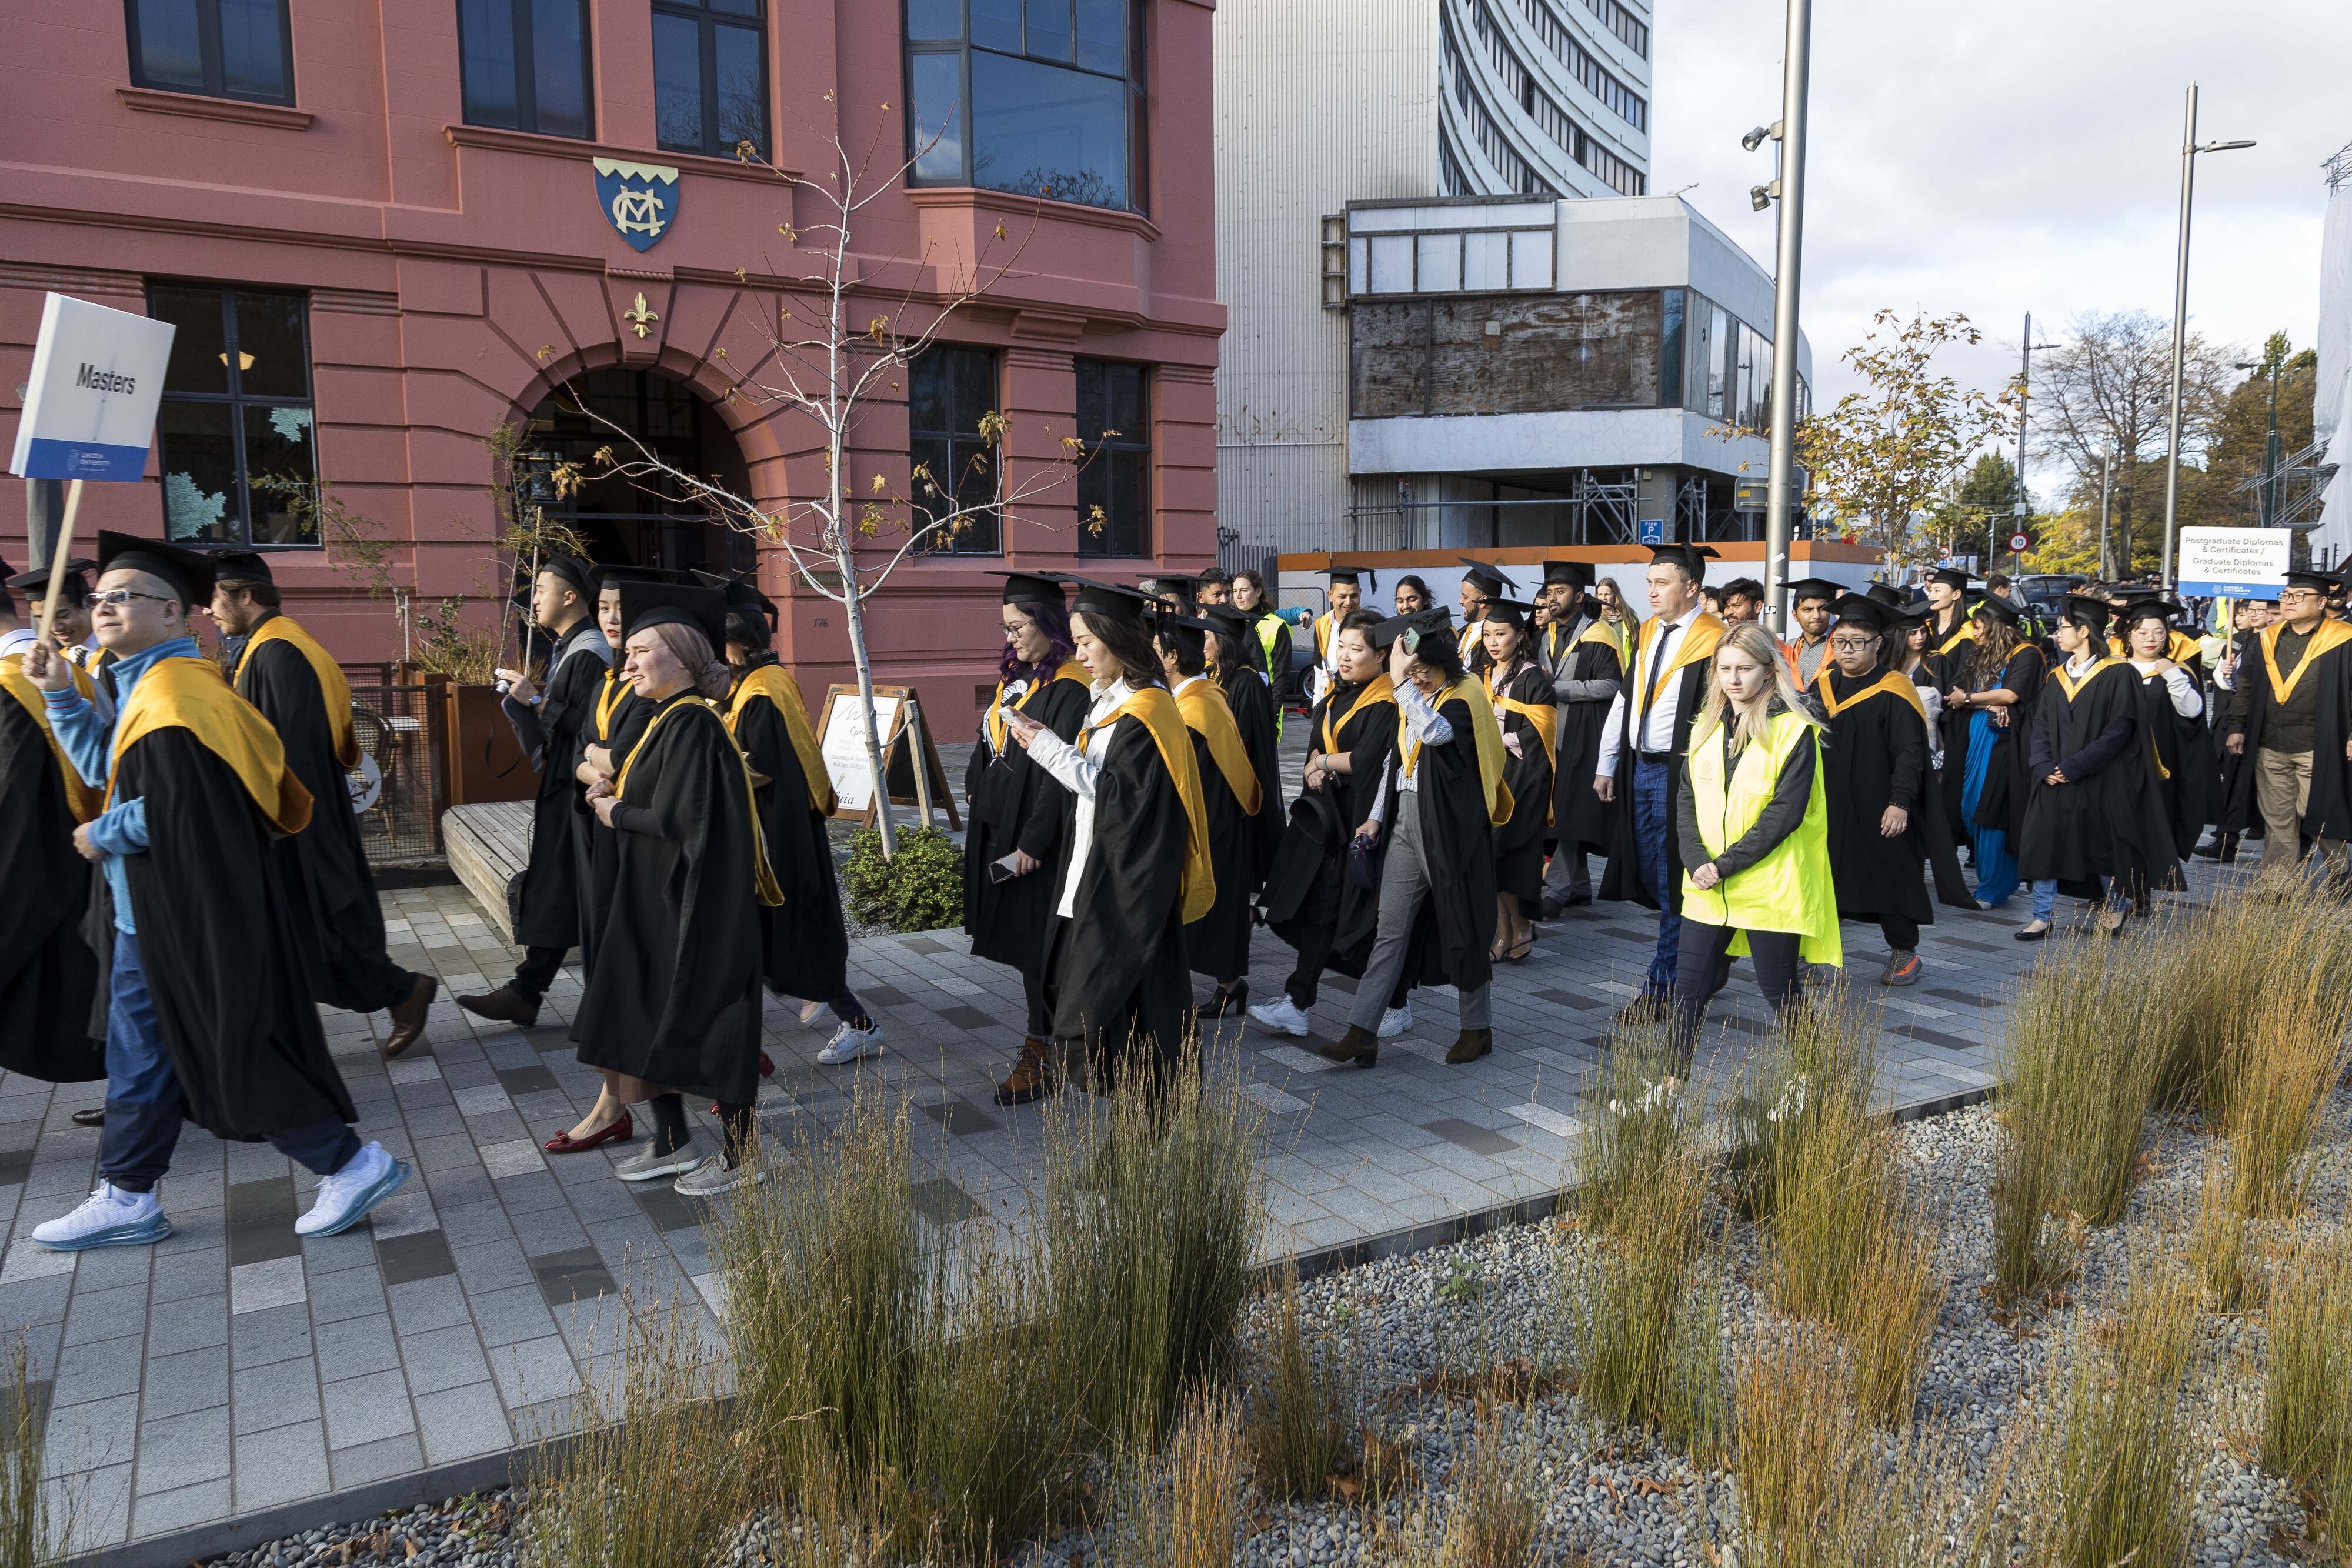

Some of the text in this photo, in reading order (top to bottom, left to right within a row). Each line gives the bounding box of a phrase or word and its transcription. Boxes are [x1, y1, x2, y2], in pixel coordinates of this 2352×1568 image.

[76, 362, 135, 395] Masters
[1648, 526, 1654, 535] P
[2014, 538, 2024, 546] 10
[2186, 536, 2283, 546] Postgraduate Diplomas
[2210, 546, 2259, 554] Certificates
[2234, 559, 2274, 567] Diplomas
[2212, 567, 2261, 575] Certificates
[813, 618, 828, 628] 176
